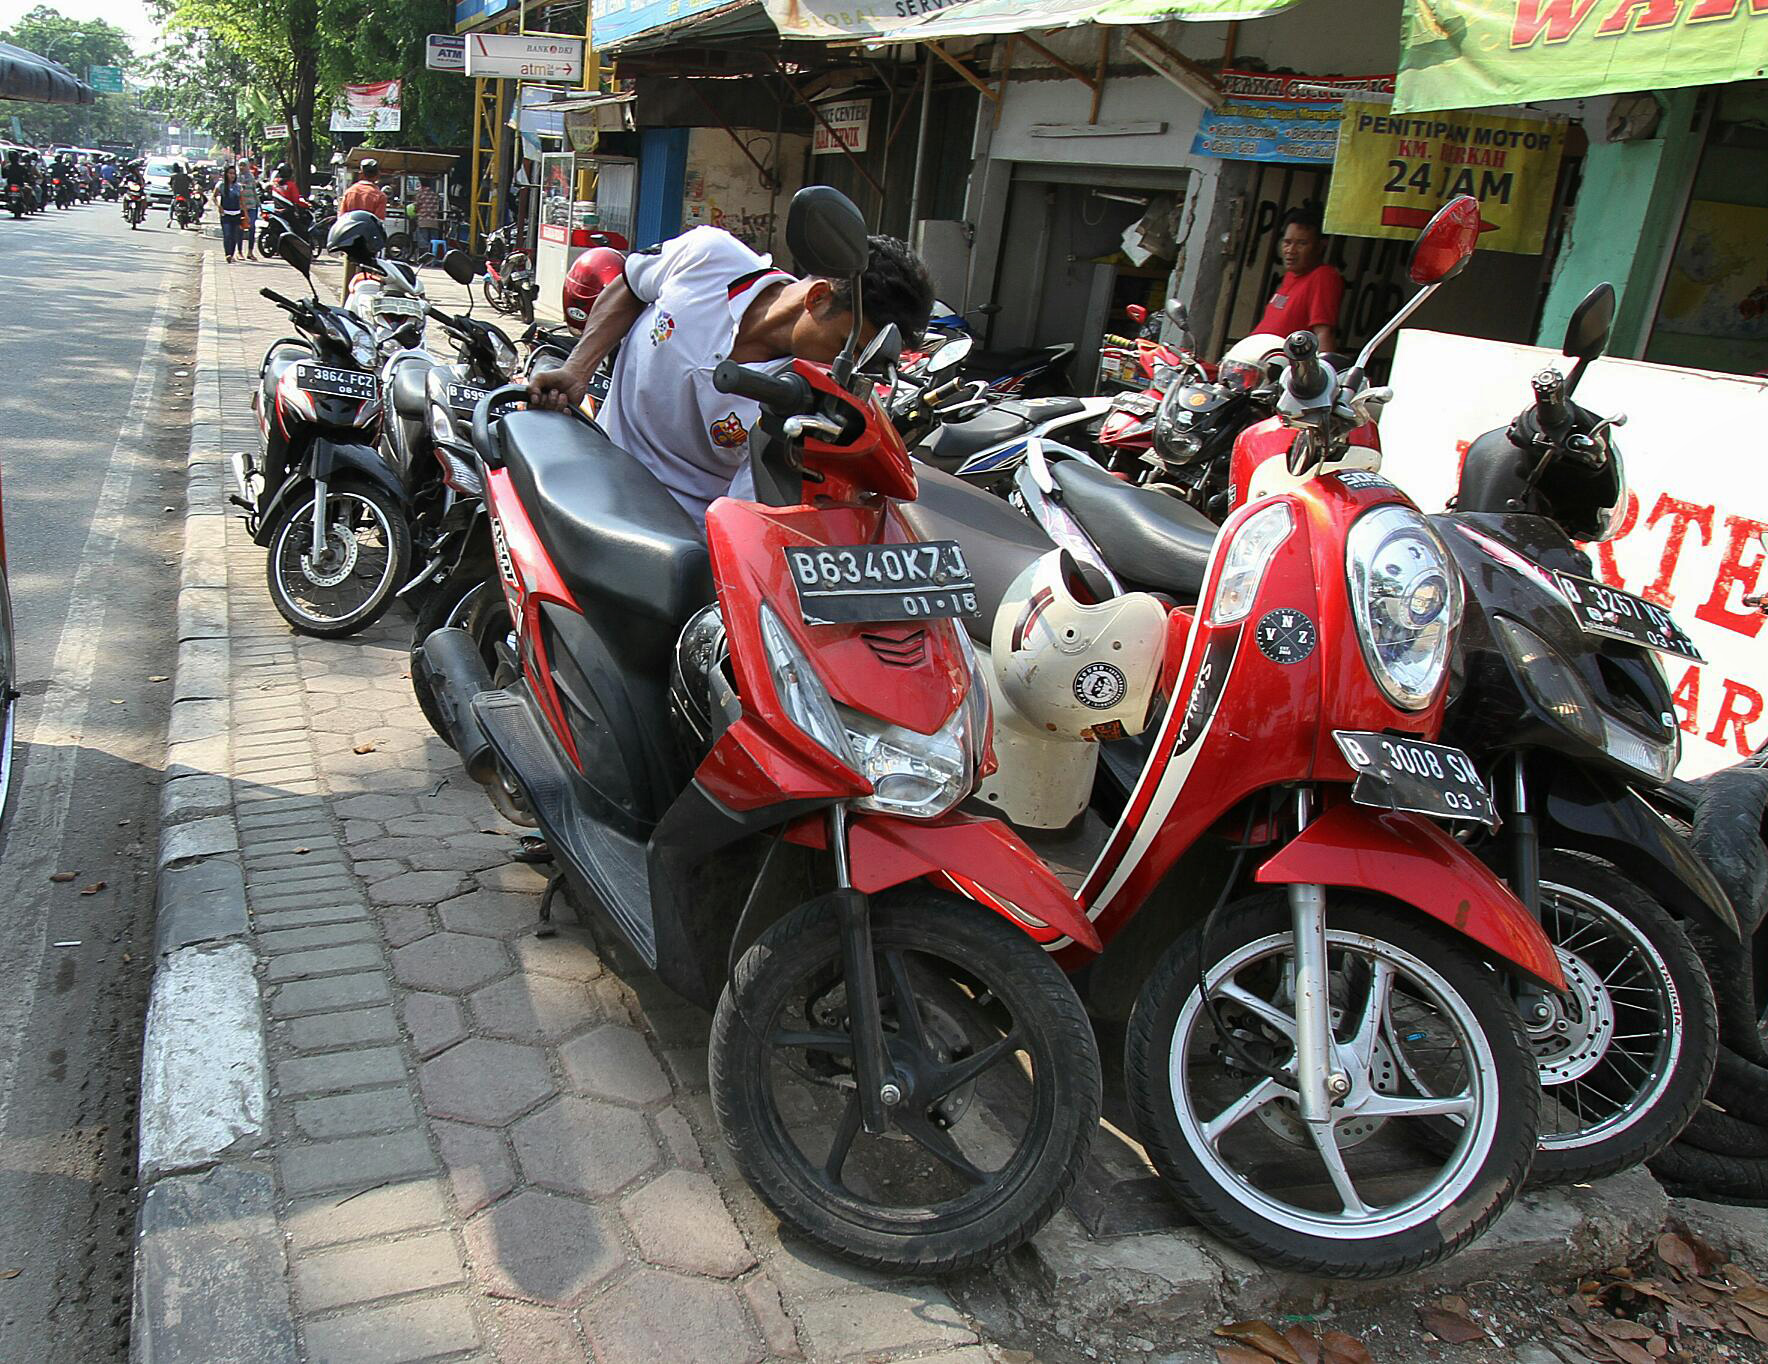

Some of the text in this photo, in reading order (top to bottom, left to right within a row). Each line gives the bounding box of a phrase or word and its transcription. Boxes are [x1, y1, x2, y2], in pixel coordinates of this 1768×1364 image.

[437, 48, 463, 59] ATM
[520, 62, 547, 76] atm
[1358, 114, 1551, 151] PENITIPAN MOTOR
[1382, 159, 1514, 205] 24 JAM
[298, 366, 373, 388] B 3864 FCZ
[450, 386, 489, 401] B 699
[1561, 577, 1582, 604] B
[1588, 585, 1642, 620] 3267
[1342, 737, 1371, 766] B
[1381, 741, 1445, 780] 3008
[1660, 965, 1682, 1025] YAMAHA
